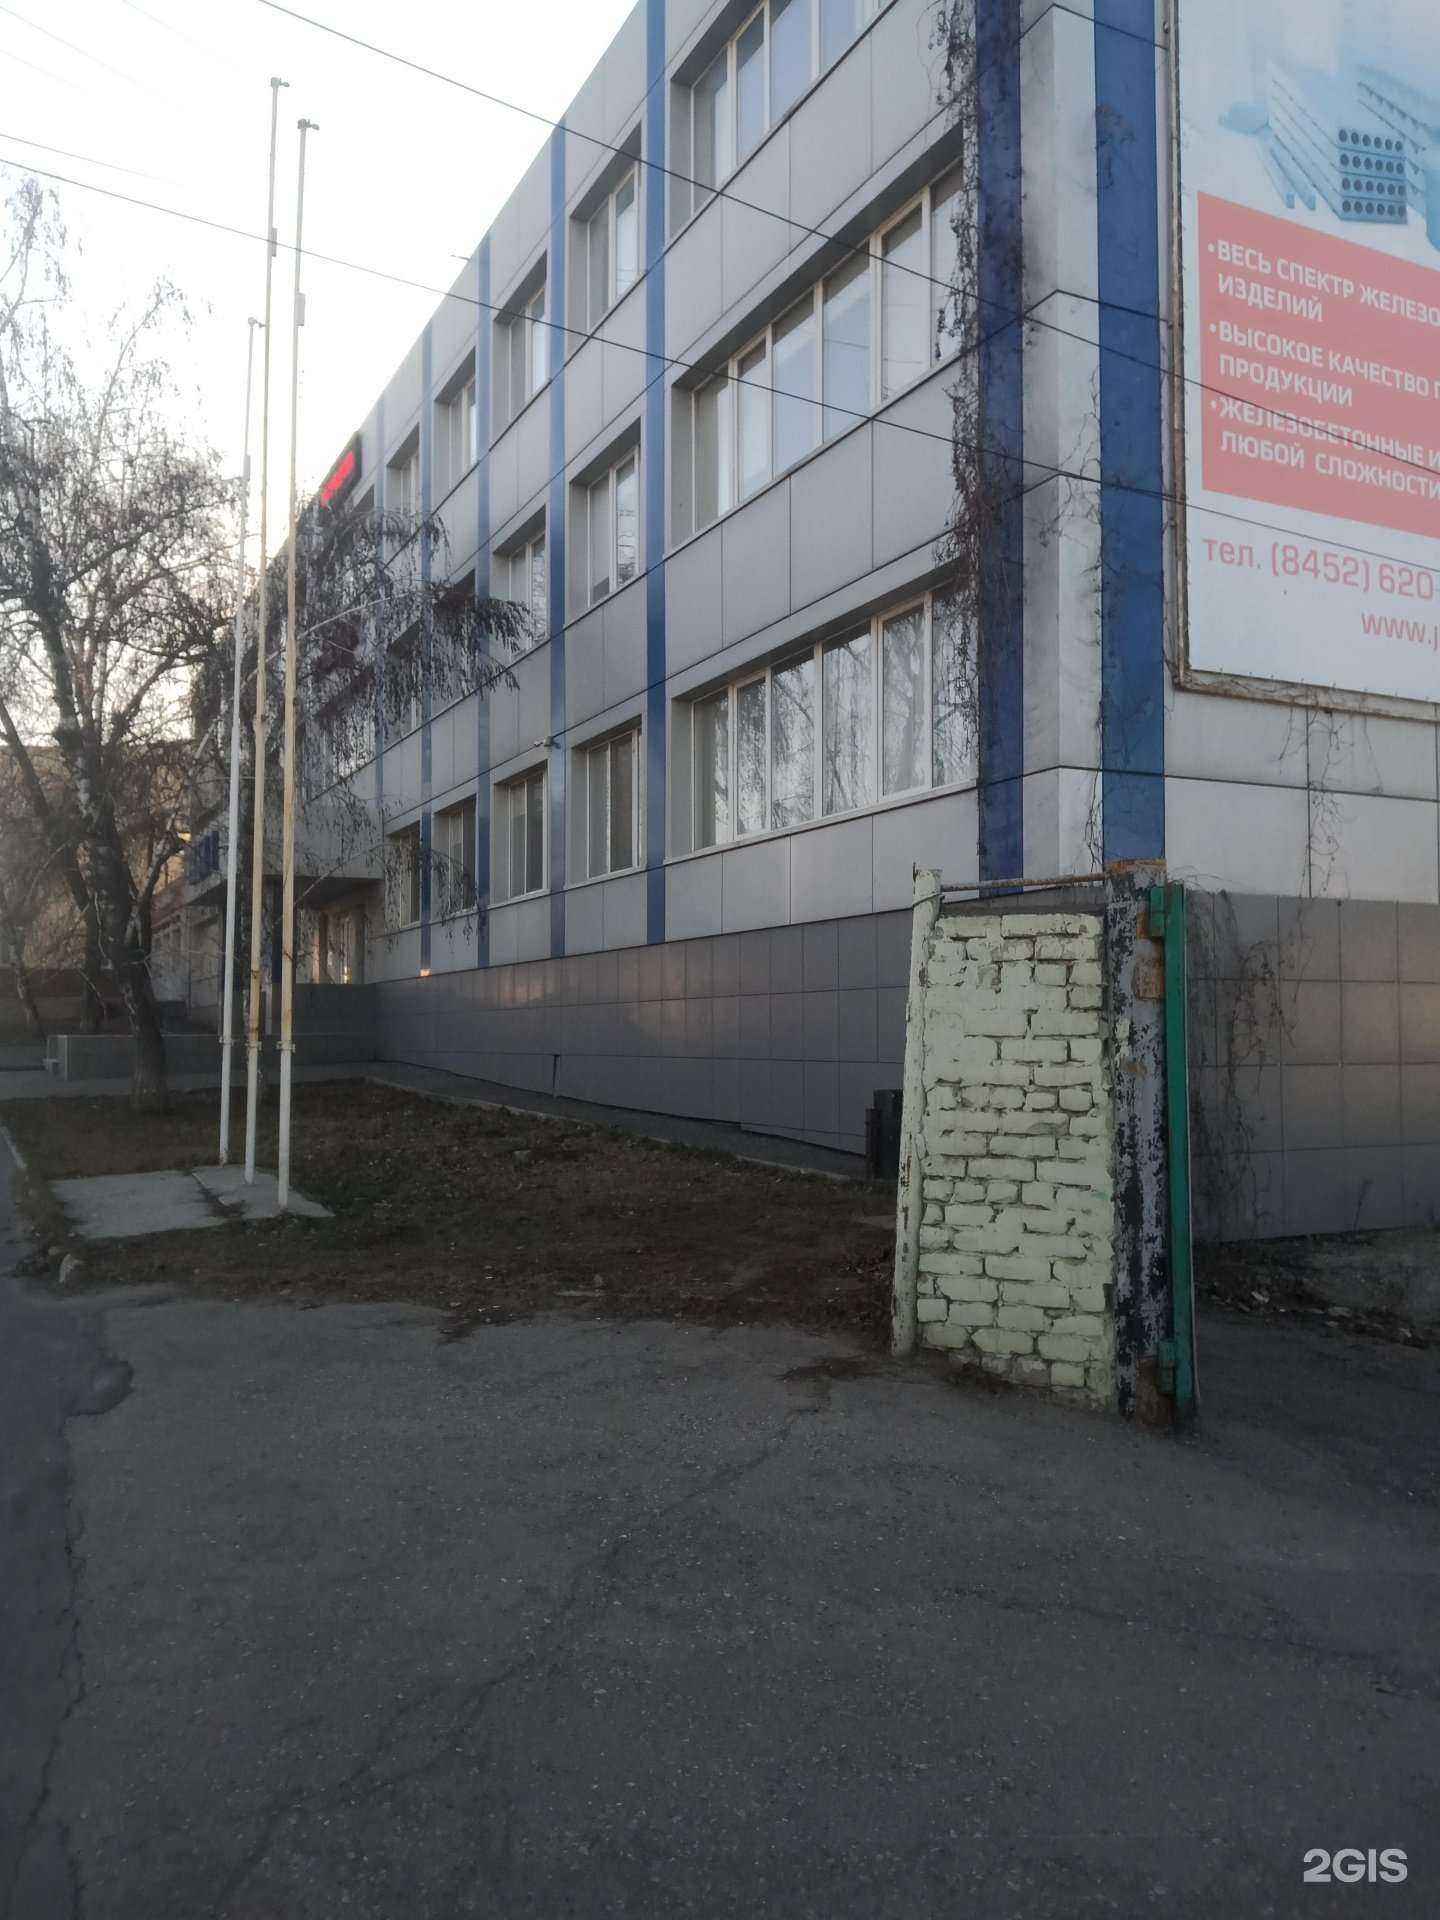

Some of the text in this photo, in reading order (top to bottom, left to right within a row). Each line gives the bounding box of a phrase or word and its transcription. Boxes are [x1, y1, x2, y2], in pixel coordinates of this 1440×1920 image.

[1217, 239, 1272, 275] ВЕСЬ
[1276, 256, 1354, 299] СПЕКТР
[1218, 272, 1323, 322] ИЗДЕЛИЙ
[1219, 319, 1324, 368] ВЫСОКОЕ
[1328, 349, 1429, 398] КАЧЕСТВО
[1219, 353, 1353, 408] ПРОДУКЦИИ
[1218, 396, 1424, 466] ЖЕЛЕЗОБЕТОННЫЕ
[1220, 430, 1440, 500] ЛЮБОЙ СЛОЖНОСТИ
[1202, 537, 1262, 569] тел.
[1271, 541, 1370, 593] (8452)
